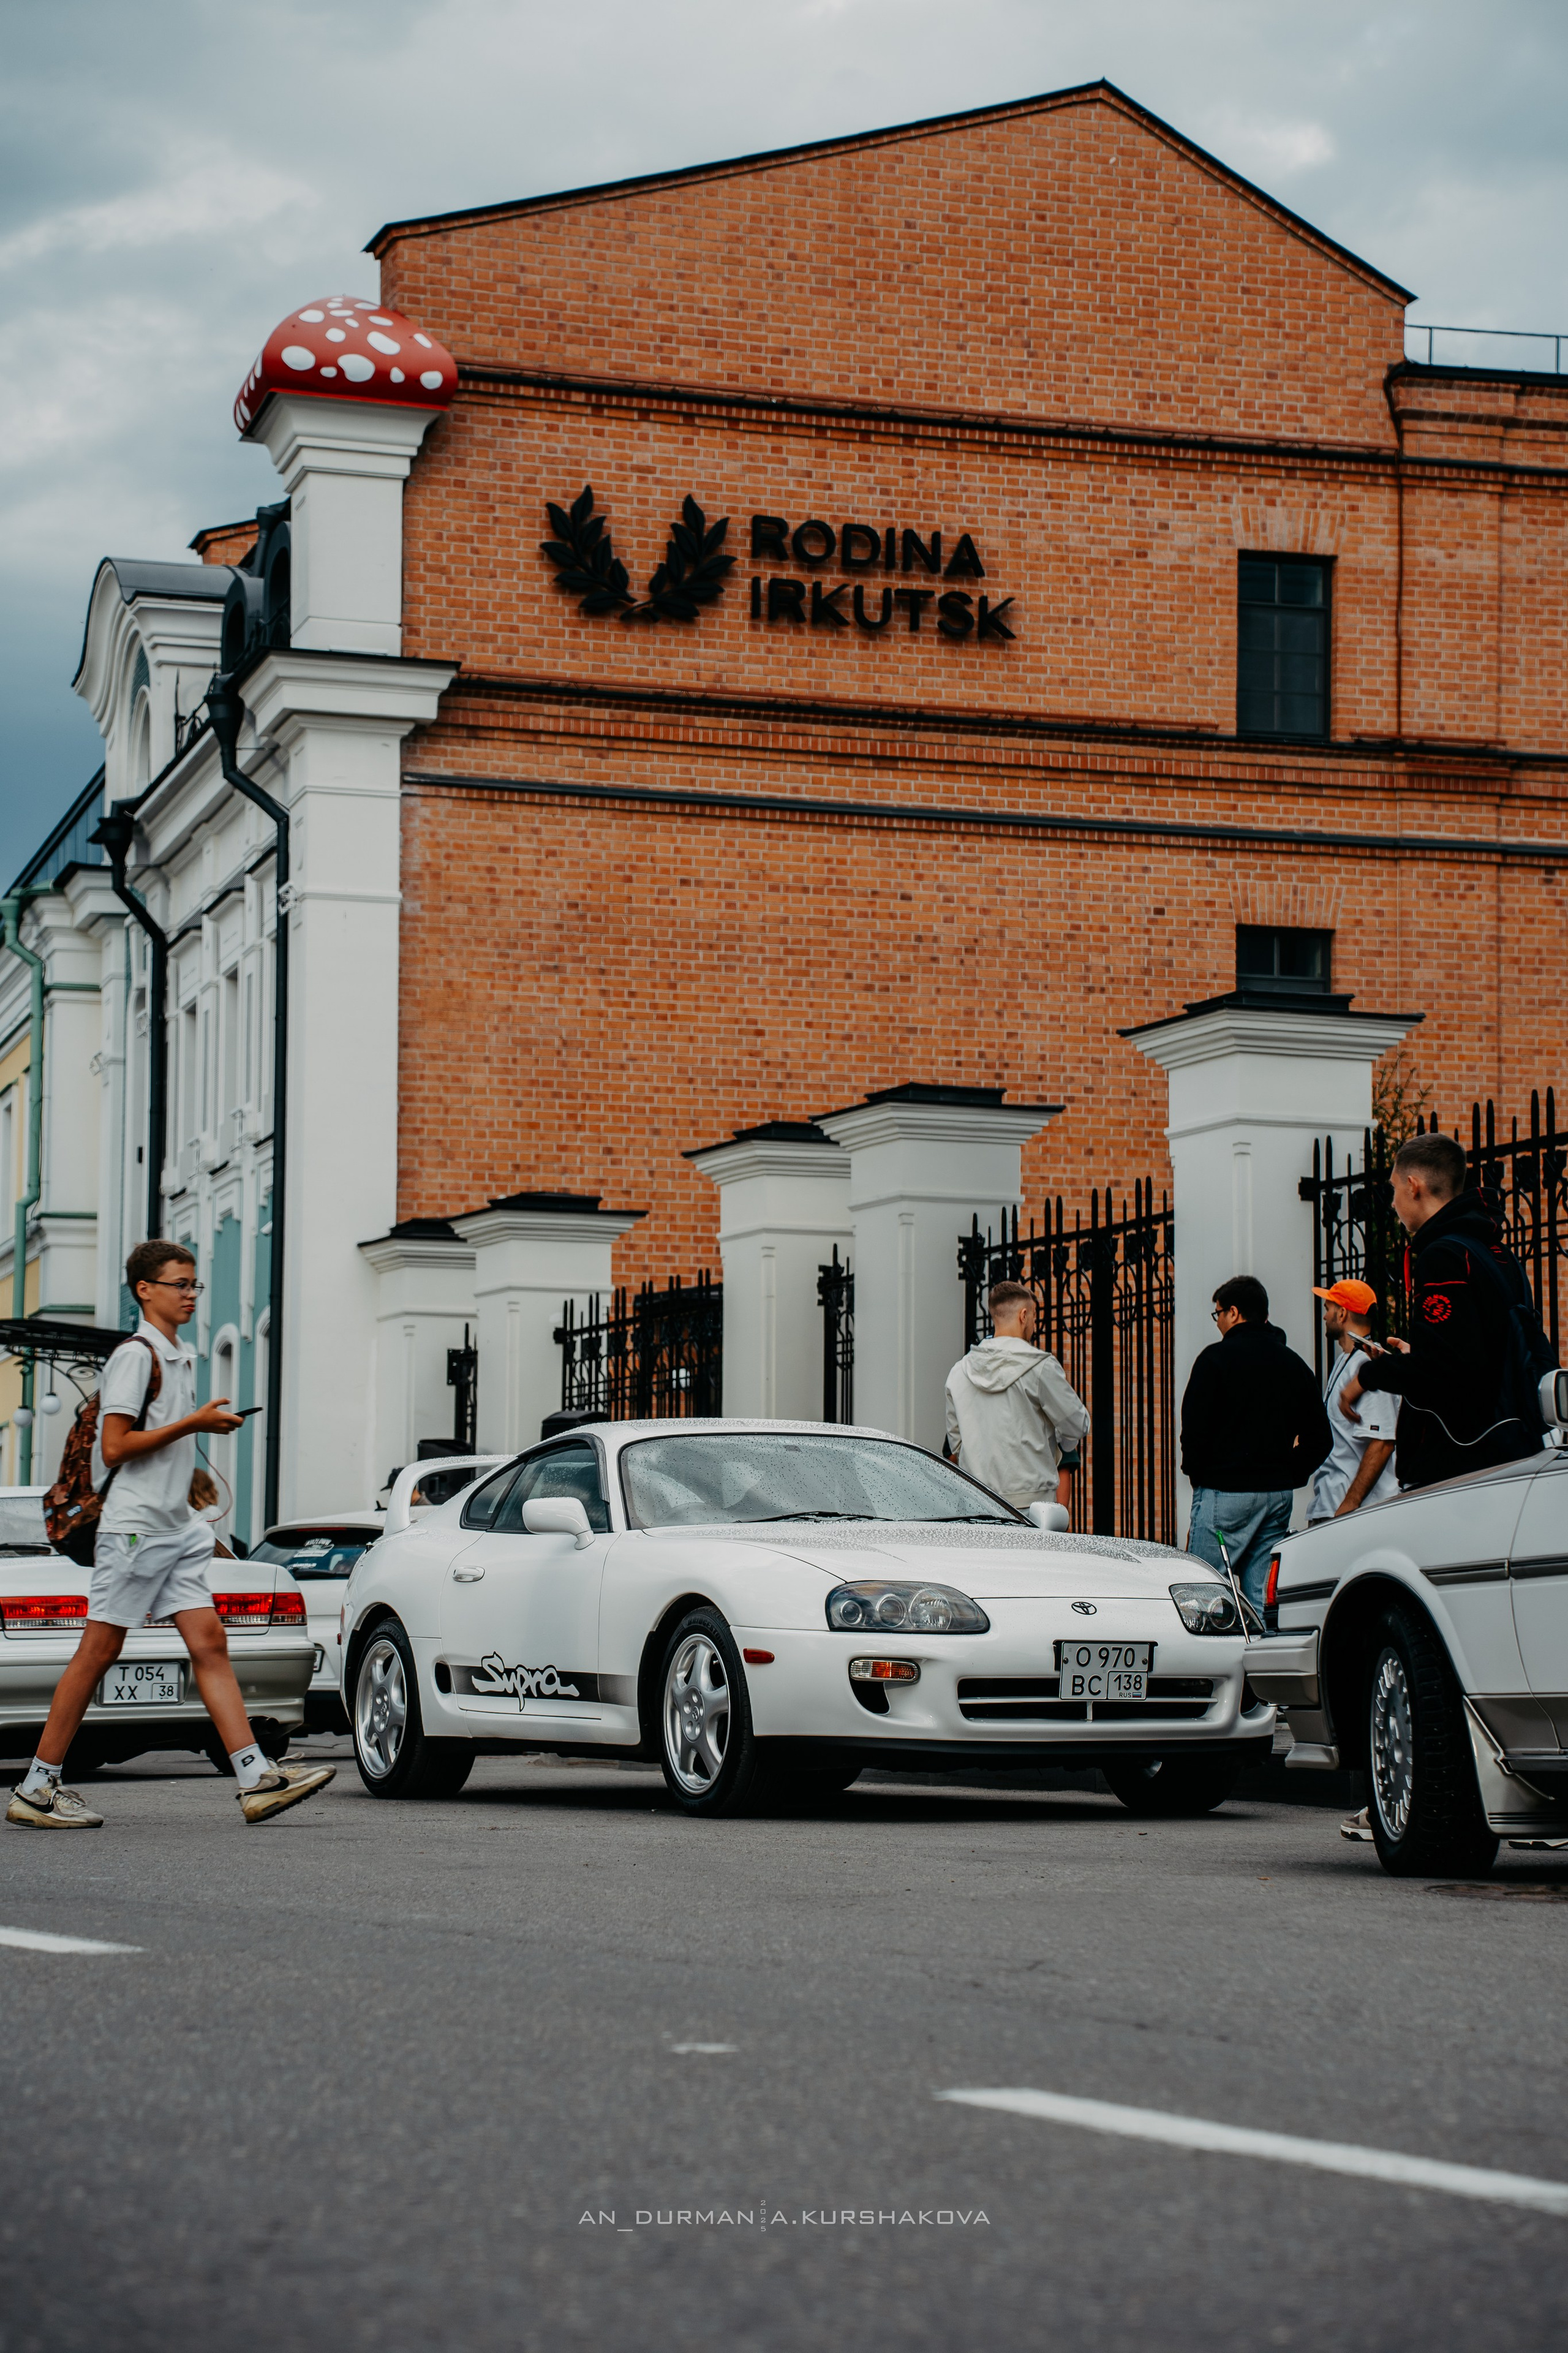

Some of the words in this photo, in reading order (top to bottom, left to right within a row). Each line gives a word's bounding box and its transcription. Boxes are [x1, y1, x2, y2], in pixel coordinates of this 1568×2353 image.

[752, 515, 985, 578] RODINA
[751, 576, 1017, 640] IRKUTSK
[1098, 1647, 1135, 1667] 970
[135, 1666, 164, 1681] 054
[472, 1651, 579, 1712] Supra
[1114, 1674, 1142, 1691] 138
[159, 1685, 174, 1696] 38
